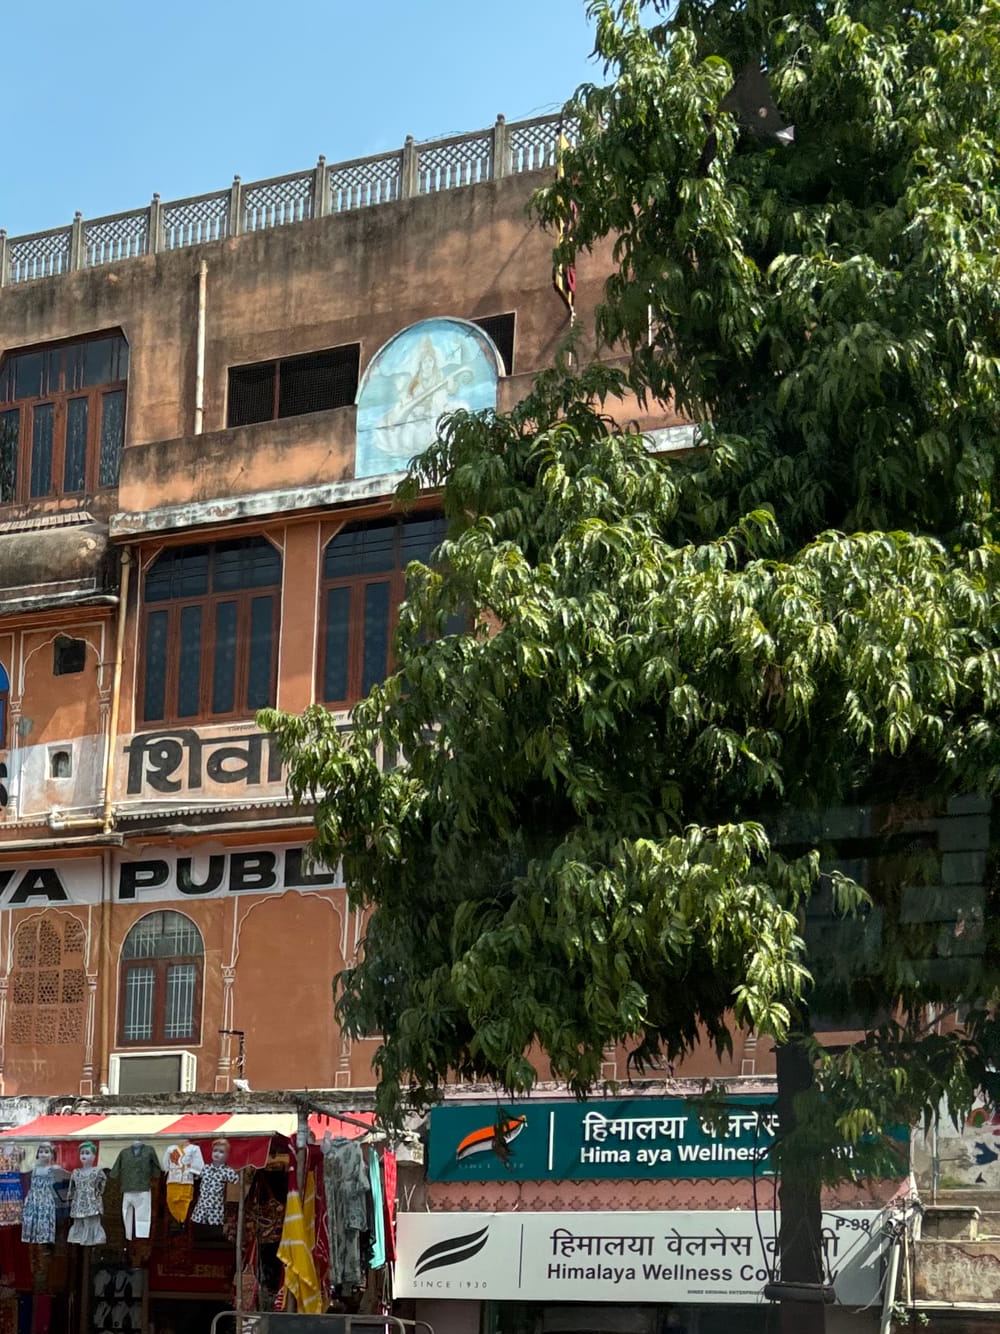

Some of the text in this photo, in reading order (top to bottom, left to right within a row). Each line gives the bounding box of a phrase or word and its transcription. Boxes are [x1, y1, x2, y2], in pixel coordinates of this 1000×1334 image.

[119, 847, 336, 899] PUBL
[582, 1112, 688, 1142] हिमालया
[677, 1145, 768, 1162] Wellness
[835, 1219, 870, 1231] P-98
[550, 1228, 655, 1257] हिमालया
[665, 1228, 752, 1257] वेलनेस
[413, 1280, 451, 1288] SINCE
[547, 1263, 636, 1284] Himalaya
[642, 1263, 733, 1281] Wellness
